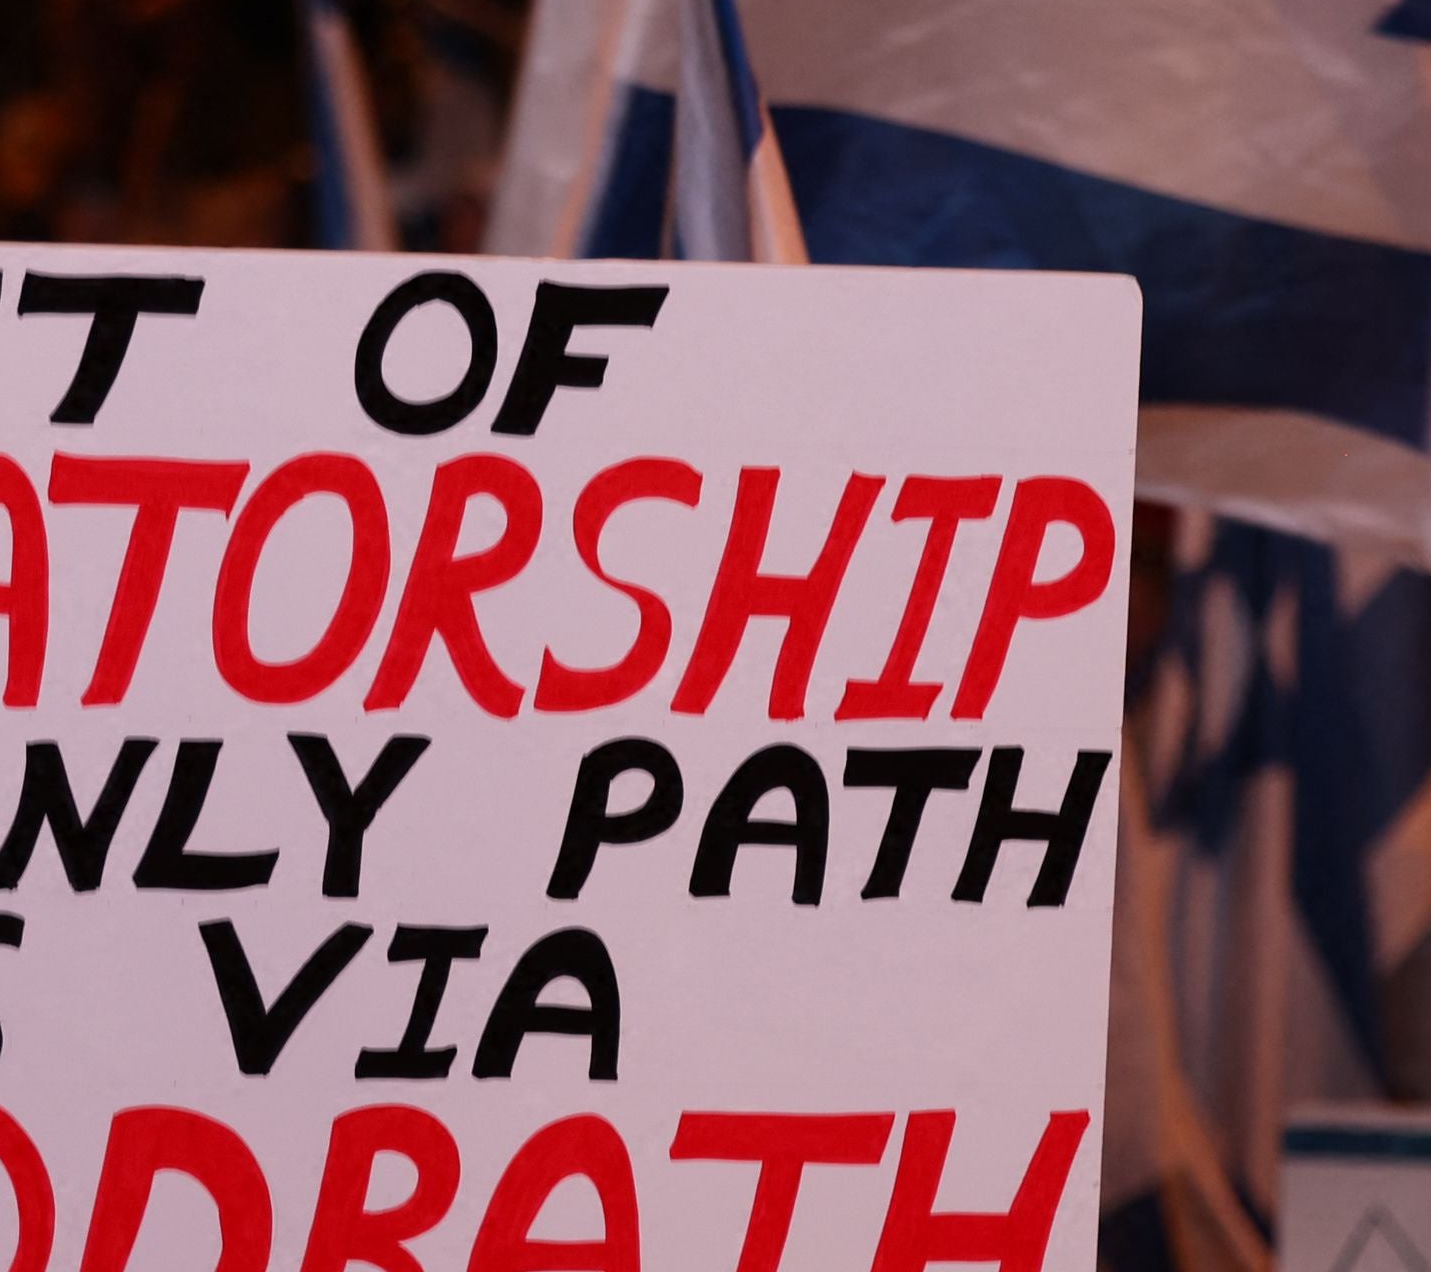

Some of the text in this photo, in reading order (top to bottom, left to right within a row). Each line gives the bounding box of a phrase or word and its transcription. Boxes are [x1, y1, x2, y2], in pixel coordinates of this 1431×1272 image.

[355, 272, 669, 436] OF
[546, 738, 1112, 908] PATH
[199, 920, 620, 1081] VIA
